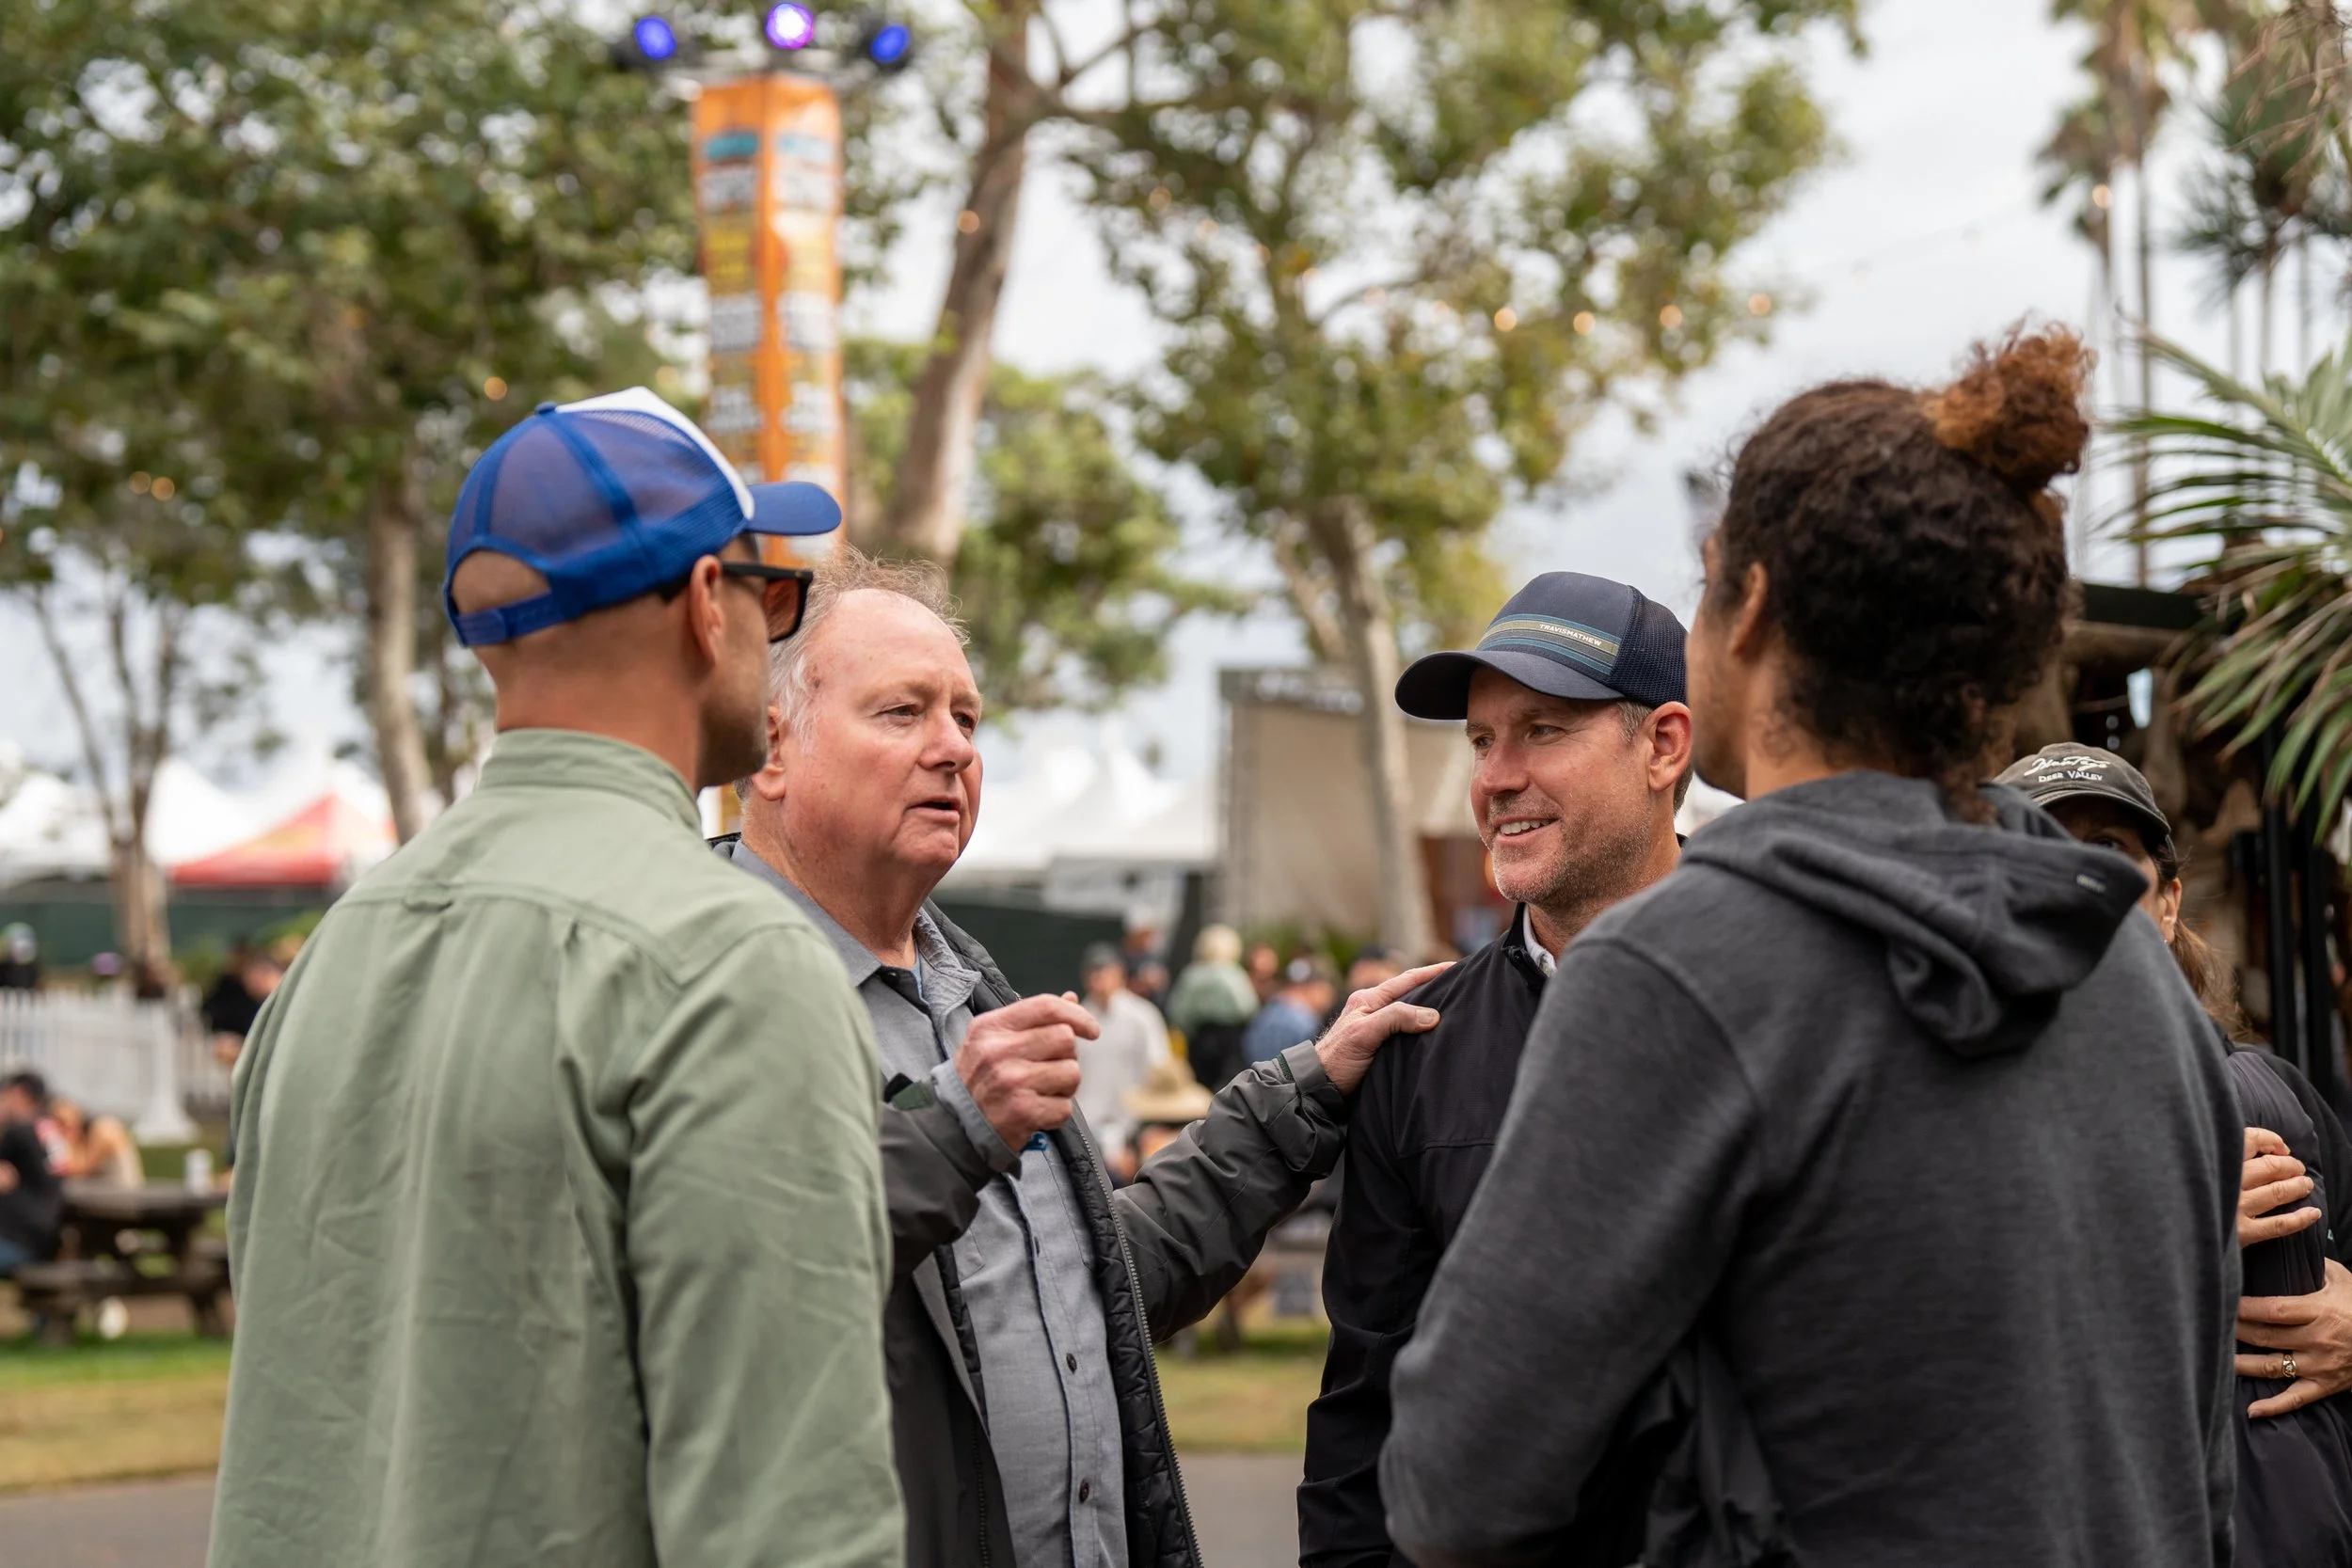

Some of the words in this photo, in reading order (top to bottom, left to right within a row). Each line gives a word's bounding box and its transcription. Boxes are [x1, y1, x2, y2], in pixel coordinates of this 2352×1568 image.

[1538, 624, 1602, 646] TRAVISMATHEW
[2039, 772, 2064, 783] DEER
[2067, 770, 2104, 781] VALLEY
